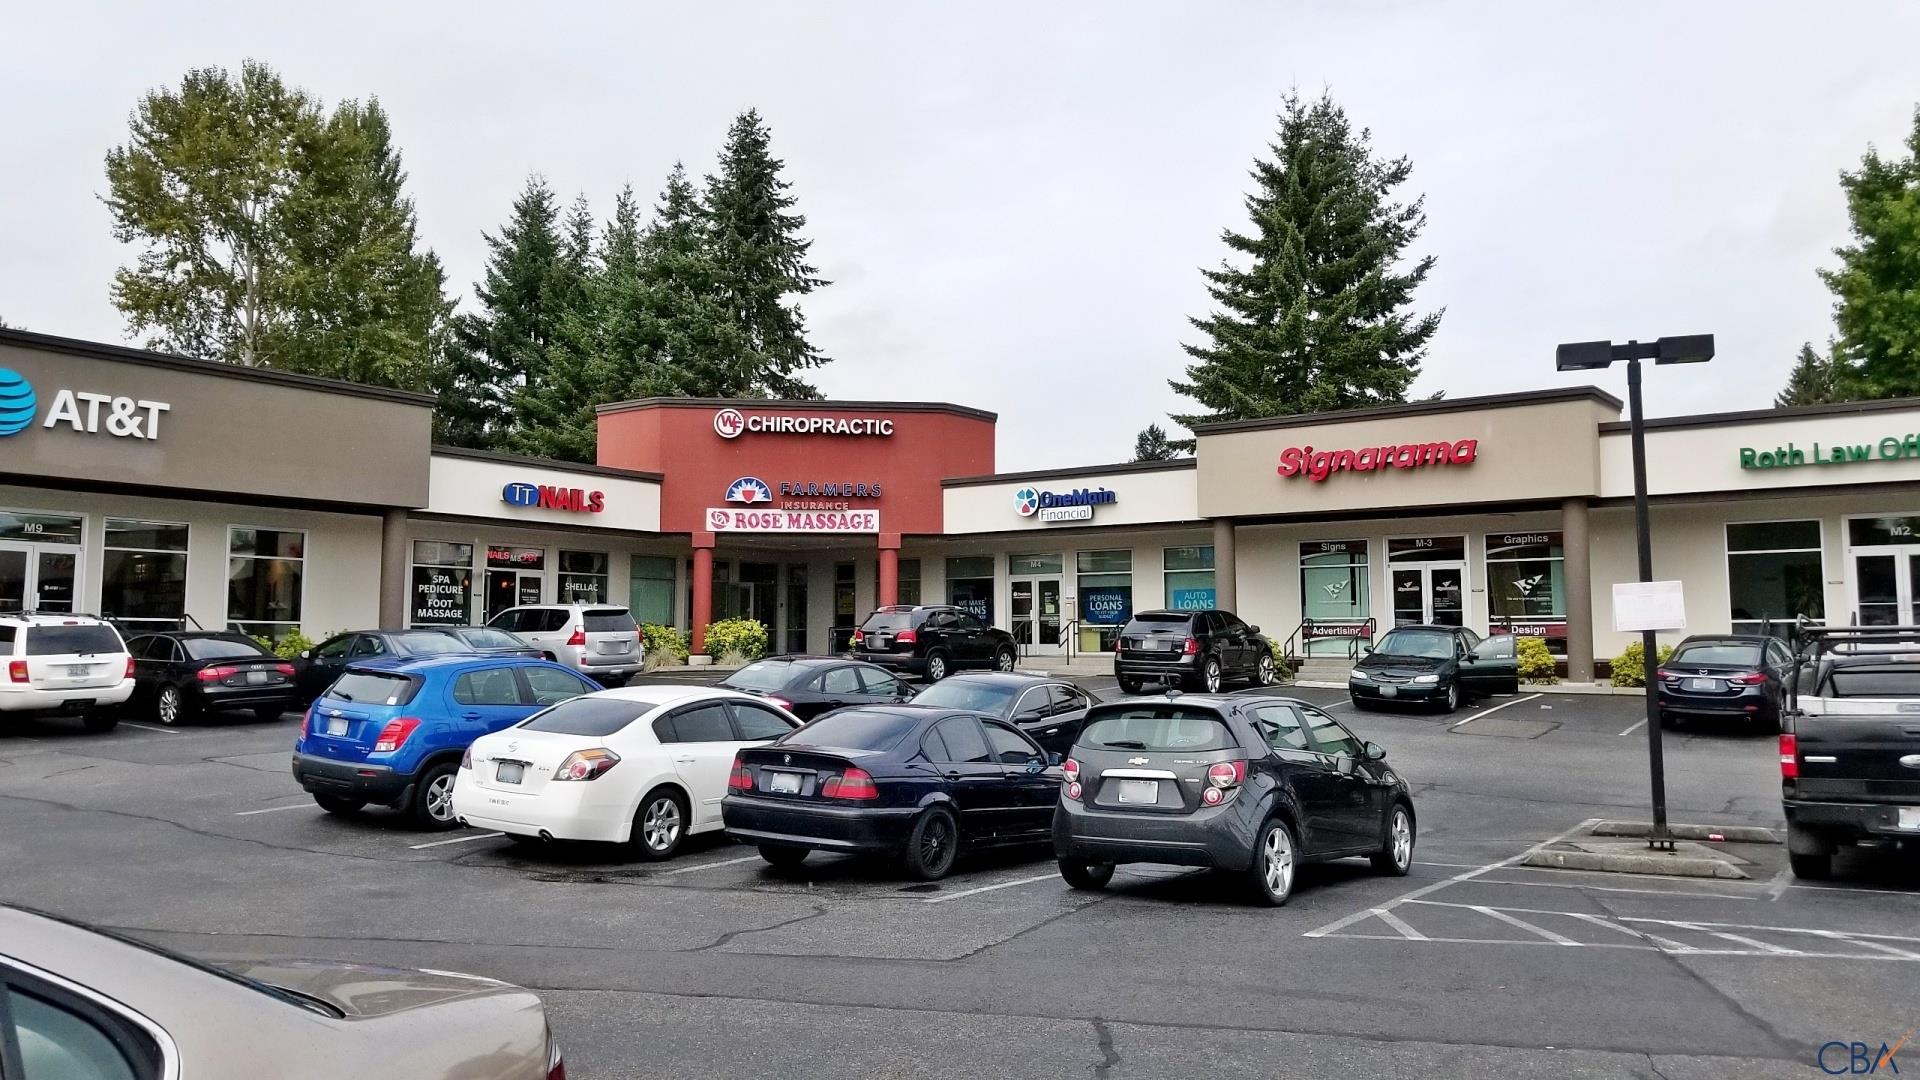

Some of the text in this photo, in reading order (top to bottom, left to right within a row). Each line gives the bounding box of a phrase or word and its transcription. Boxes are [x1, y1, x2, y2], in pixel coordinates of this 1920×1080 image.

[43, 390, 170, 439] AT&T
[748, 416, 894, 436] CHIROPRACTIC
[1277, 439, 1479, 482] Signarama
[1739, 442, 1805, 470] Roth
[1813, 442, 1871, 465] Law
[779, 482, 882, 497] FARMERS
[512, 484, 605, 513] TT NAILS
[1040, 487, 1117, 507] OneMain
[780, 501, 849, 511] INSURANCE
[1041, 508, 1090, 520] Financial
[735, 512, 875, 530] ROSE MASSAGE
[24, 523, 43, 533] M9
[1890, 526, 1912, 537] M2
[1415, 539, 1433, 547] M-3
[1504, 535, 1549, 544] Graphics
[1321, 543, 1346, 552] Signs
[486, 551, 510, 560] NAILS
[432, 575, 450, 584] SPA
[418, 584, 464, 594] PEDICURE
[565, 582, 598, 592] SHELLAC
[1184, 592, 1207, 600] AUTO
[427, 599, 453, 608] FOOT
[1090, 601, 1123, 610] LOANS
[1178, 600, 1214, 609] LOANS
[417, 608, 463, 618] MASSAGE
[962, 606, 987, 615] OANS
[1312, 626, 1361, 636] Advertising
[1511, 626, 1546, 635] Design
